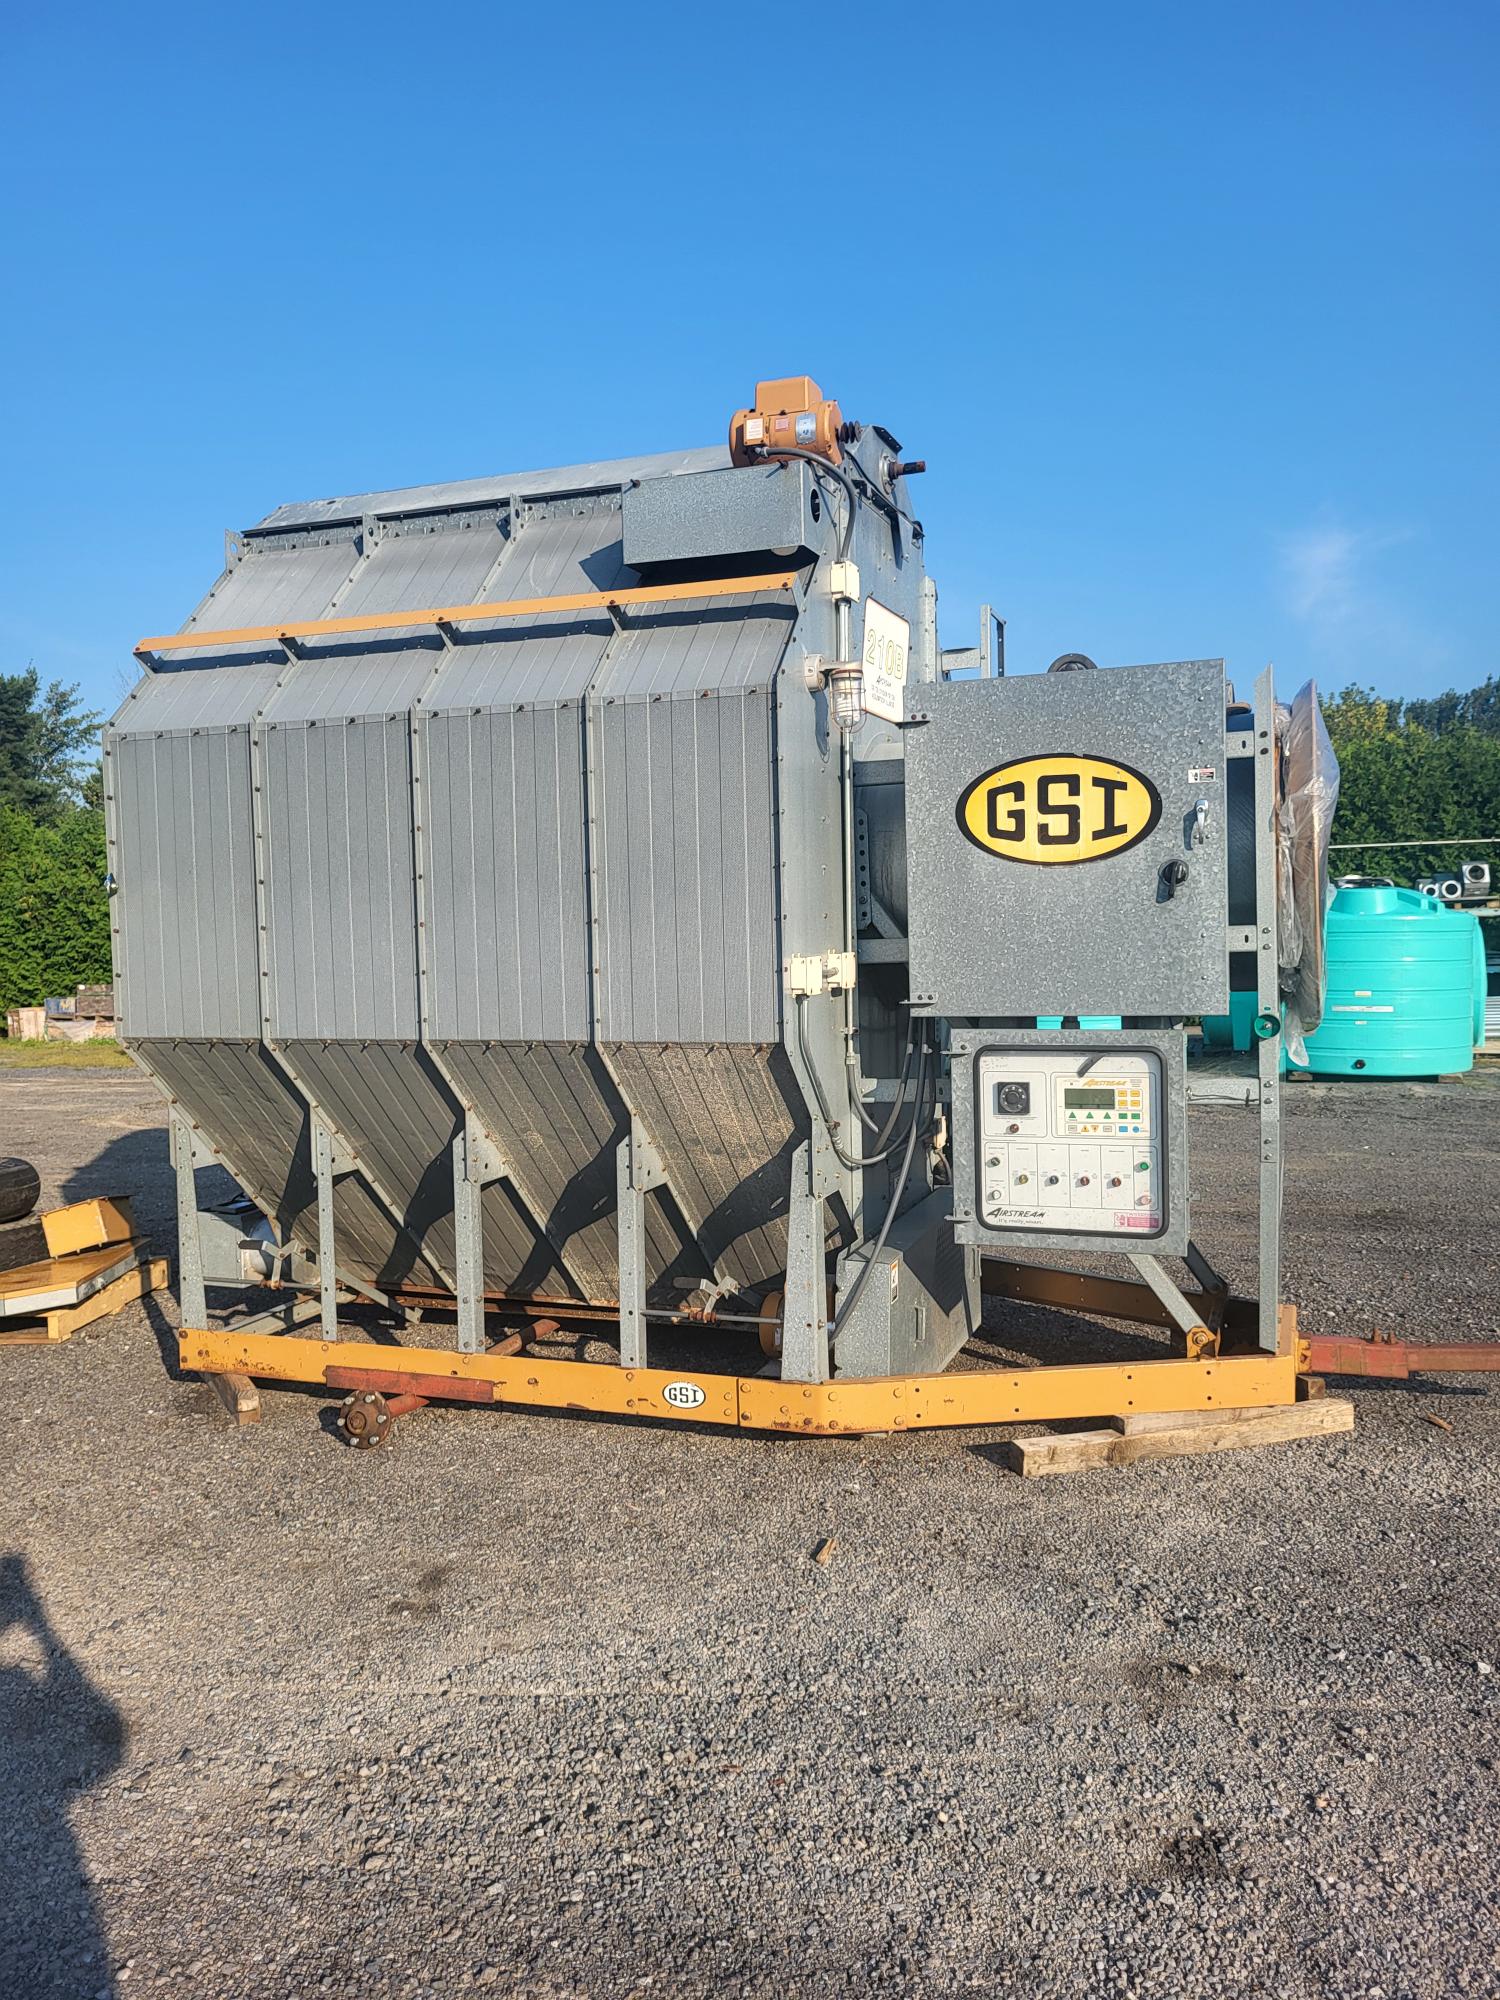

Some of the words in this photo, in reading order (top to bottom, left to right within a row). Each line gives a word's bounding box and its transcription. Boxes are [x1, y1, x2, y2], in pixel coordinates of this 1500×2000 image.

[866, 628, 904, 680] 210B
[987, 773, 1127, 845] GSI
[987, 1207, 1046, 1218] AIRSTREAM
[669, 1387, 699, 1403] GSI
